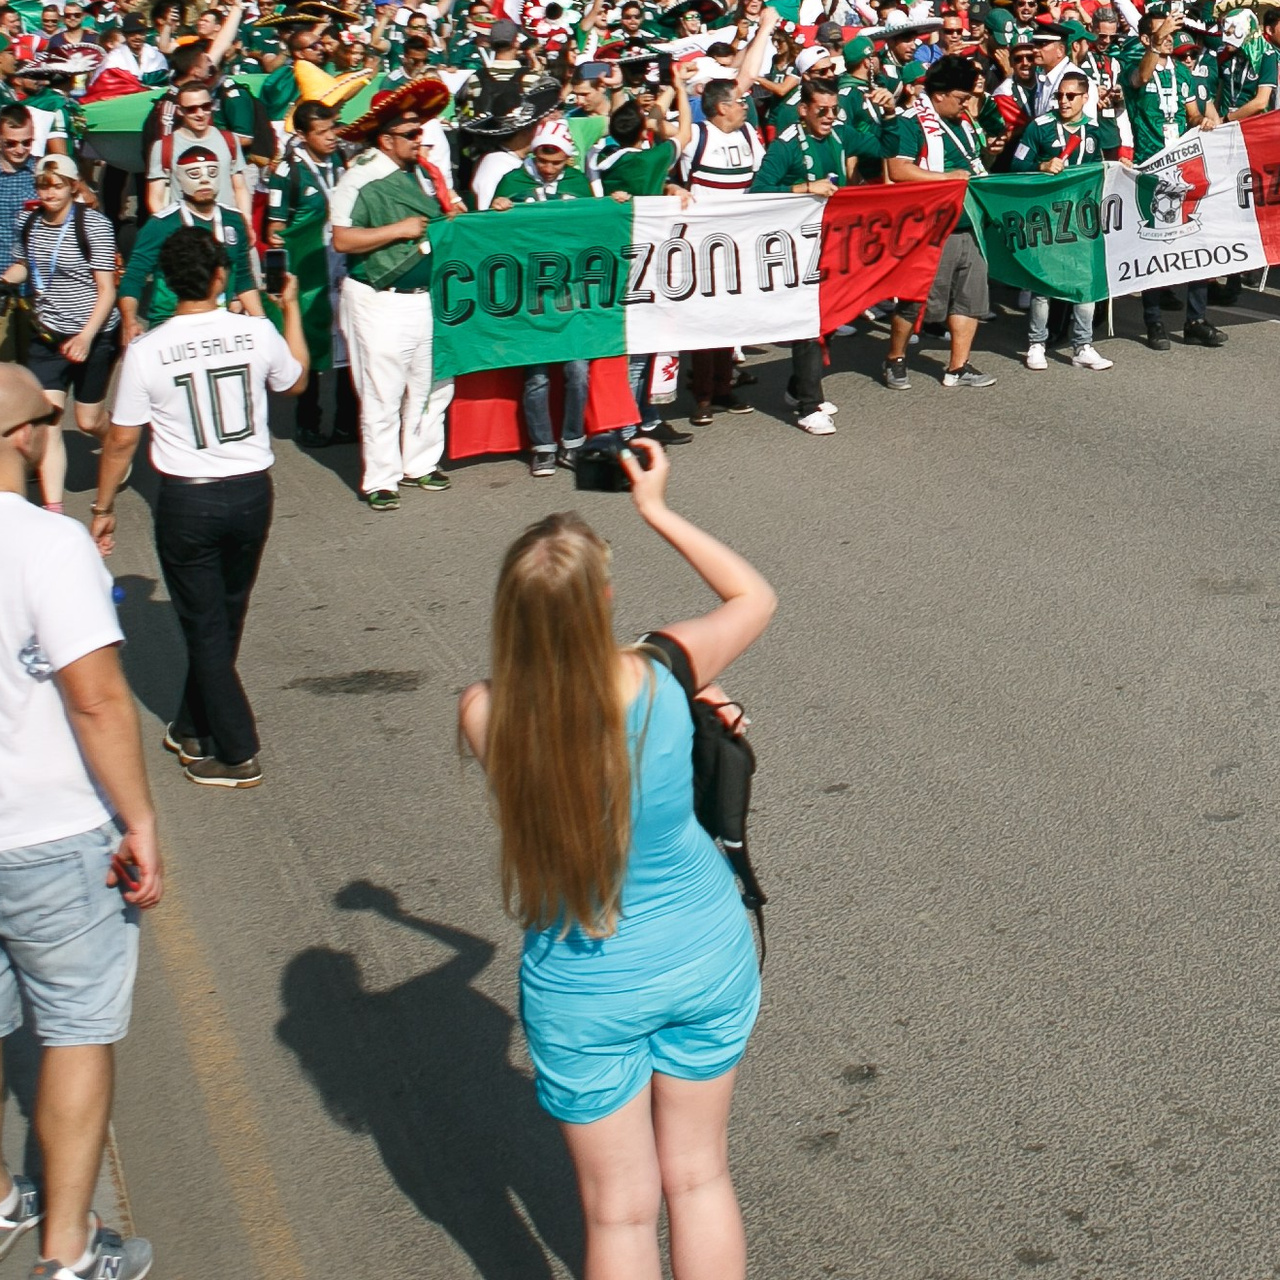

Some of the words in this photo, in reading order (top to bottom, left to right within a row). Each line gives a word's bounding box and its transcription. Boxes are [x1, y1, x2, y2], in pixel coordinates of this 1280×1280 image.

[1001, 190, 1124, 253] RAZÓN
[434, 223, 741, 327] CORAZÓN
[755, 201, 958, 292] AZTECA
[158, 341, 198, 366] LUIS
[201, 333, 256, 357] SALAS
[173, 363, 257, 450] 10
